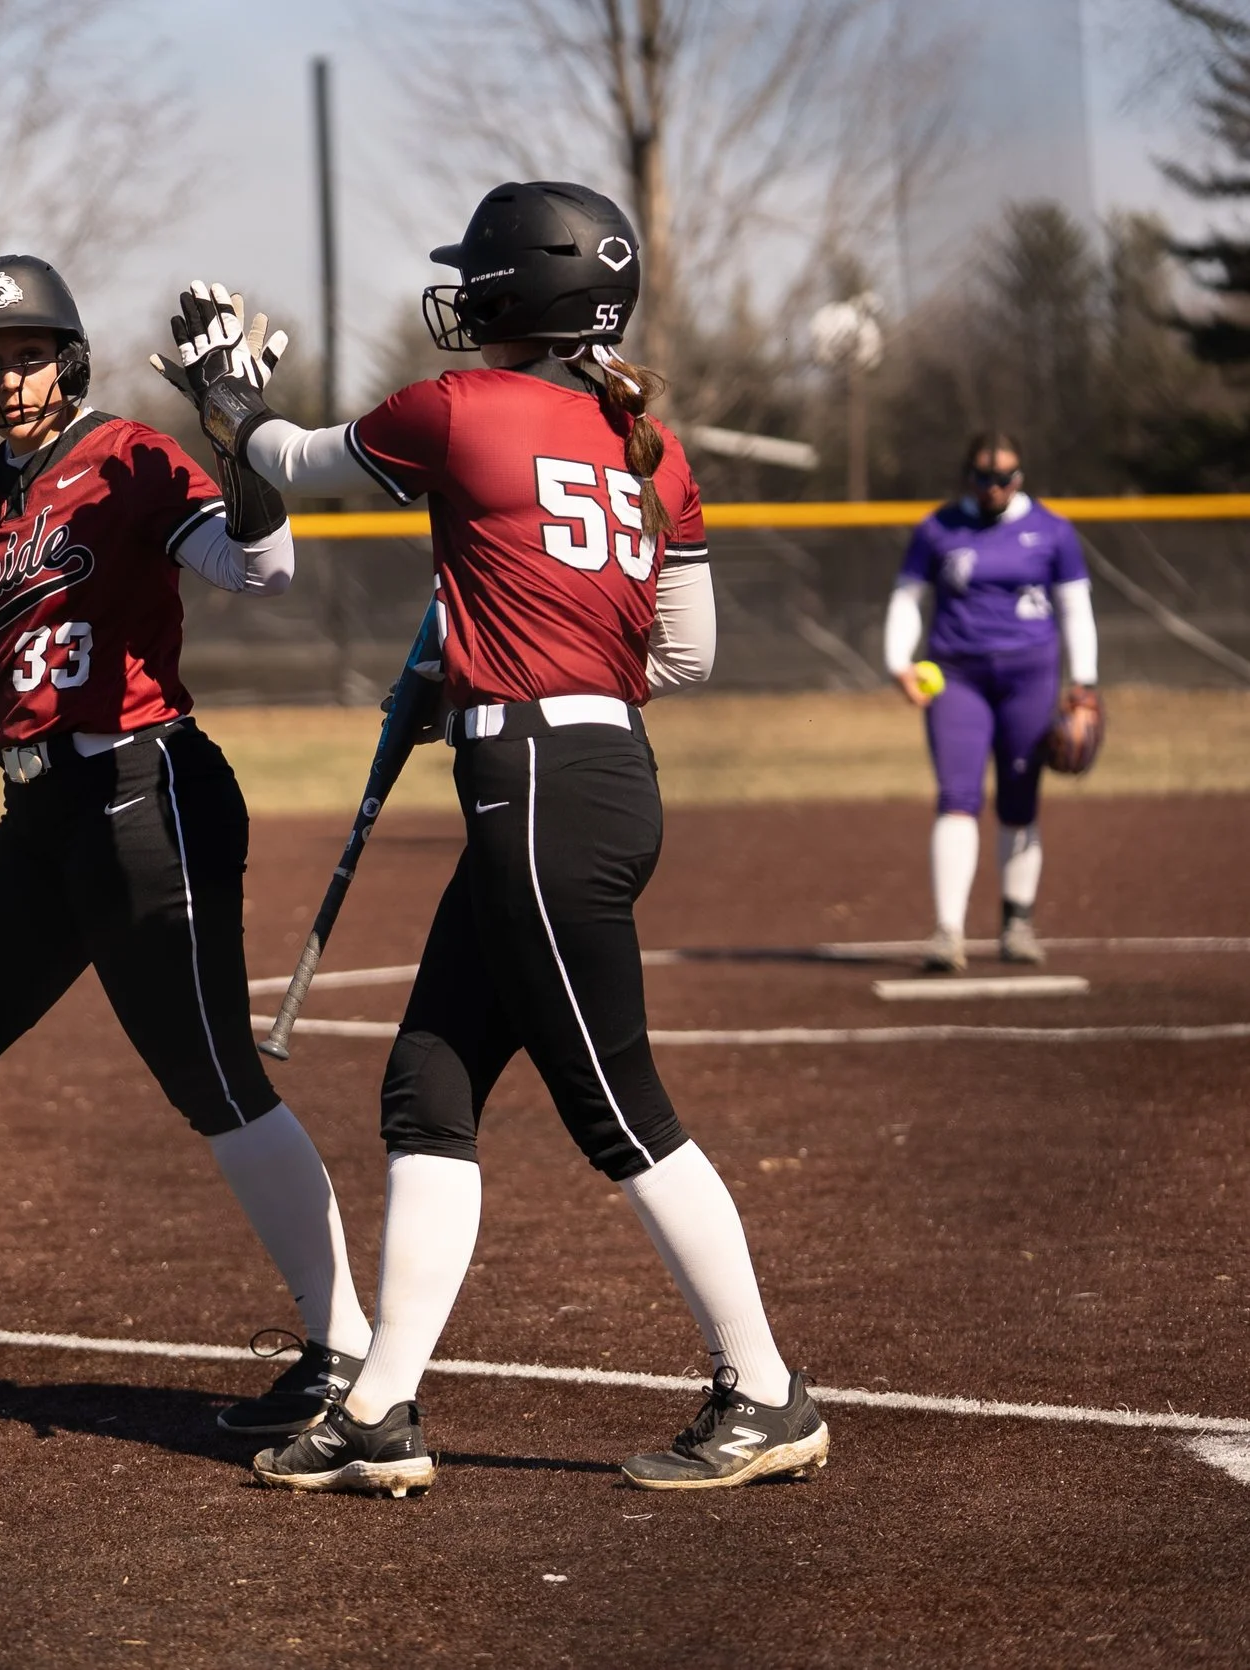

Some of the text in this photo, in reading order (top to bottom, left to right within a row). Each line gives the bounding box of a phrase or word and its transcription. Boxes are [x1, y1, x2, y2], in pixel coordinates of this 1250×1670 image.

[592, 304, 623, 330] 55
[534, 455, 657, 581] 55
[12, 621, 94, 692] 33
[311, 1424, 347, 1458] N
[719, 1425, 768, 1460] N
